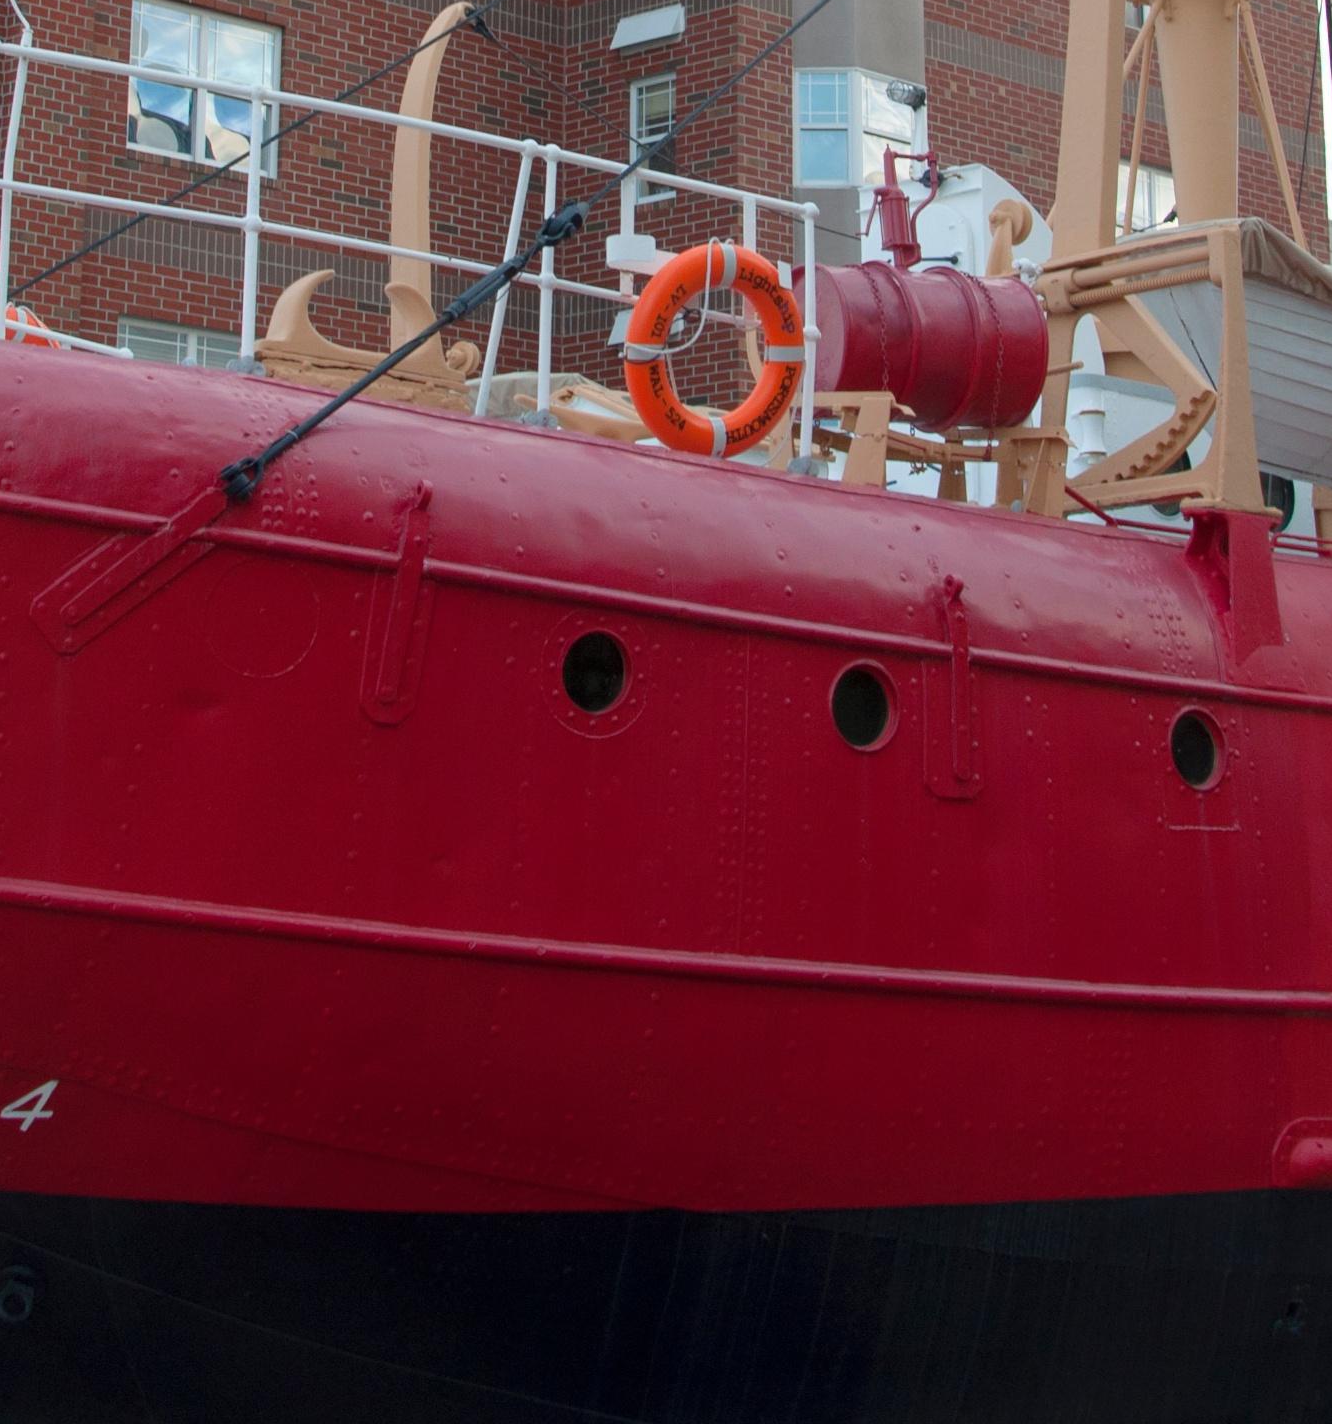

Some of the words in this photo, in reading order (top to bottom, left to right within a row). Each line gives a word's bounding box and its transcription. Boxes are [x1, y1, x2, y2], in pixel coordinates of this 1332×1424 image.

[738, 267, 795, 335] Lightship
[725, 365, 797, 445] PORTSMOUTH
[0, 1079, 59, 1132] 4
